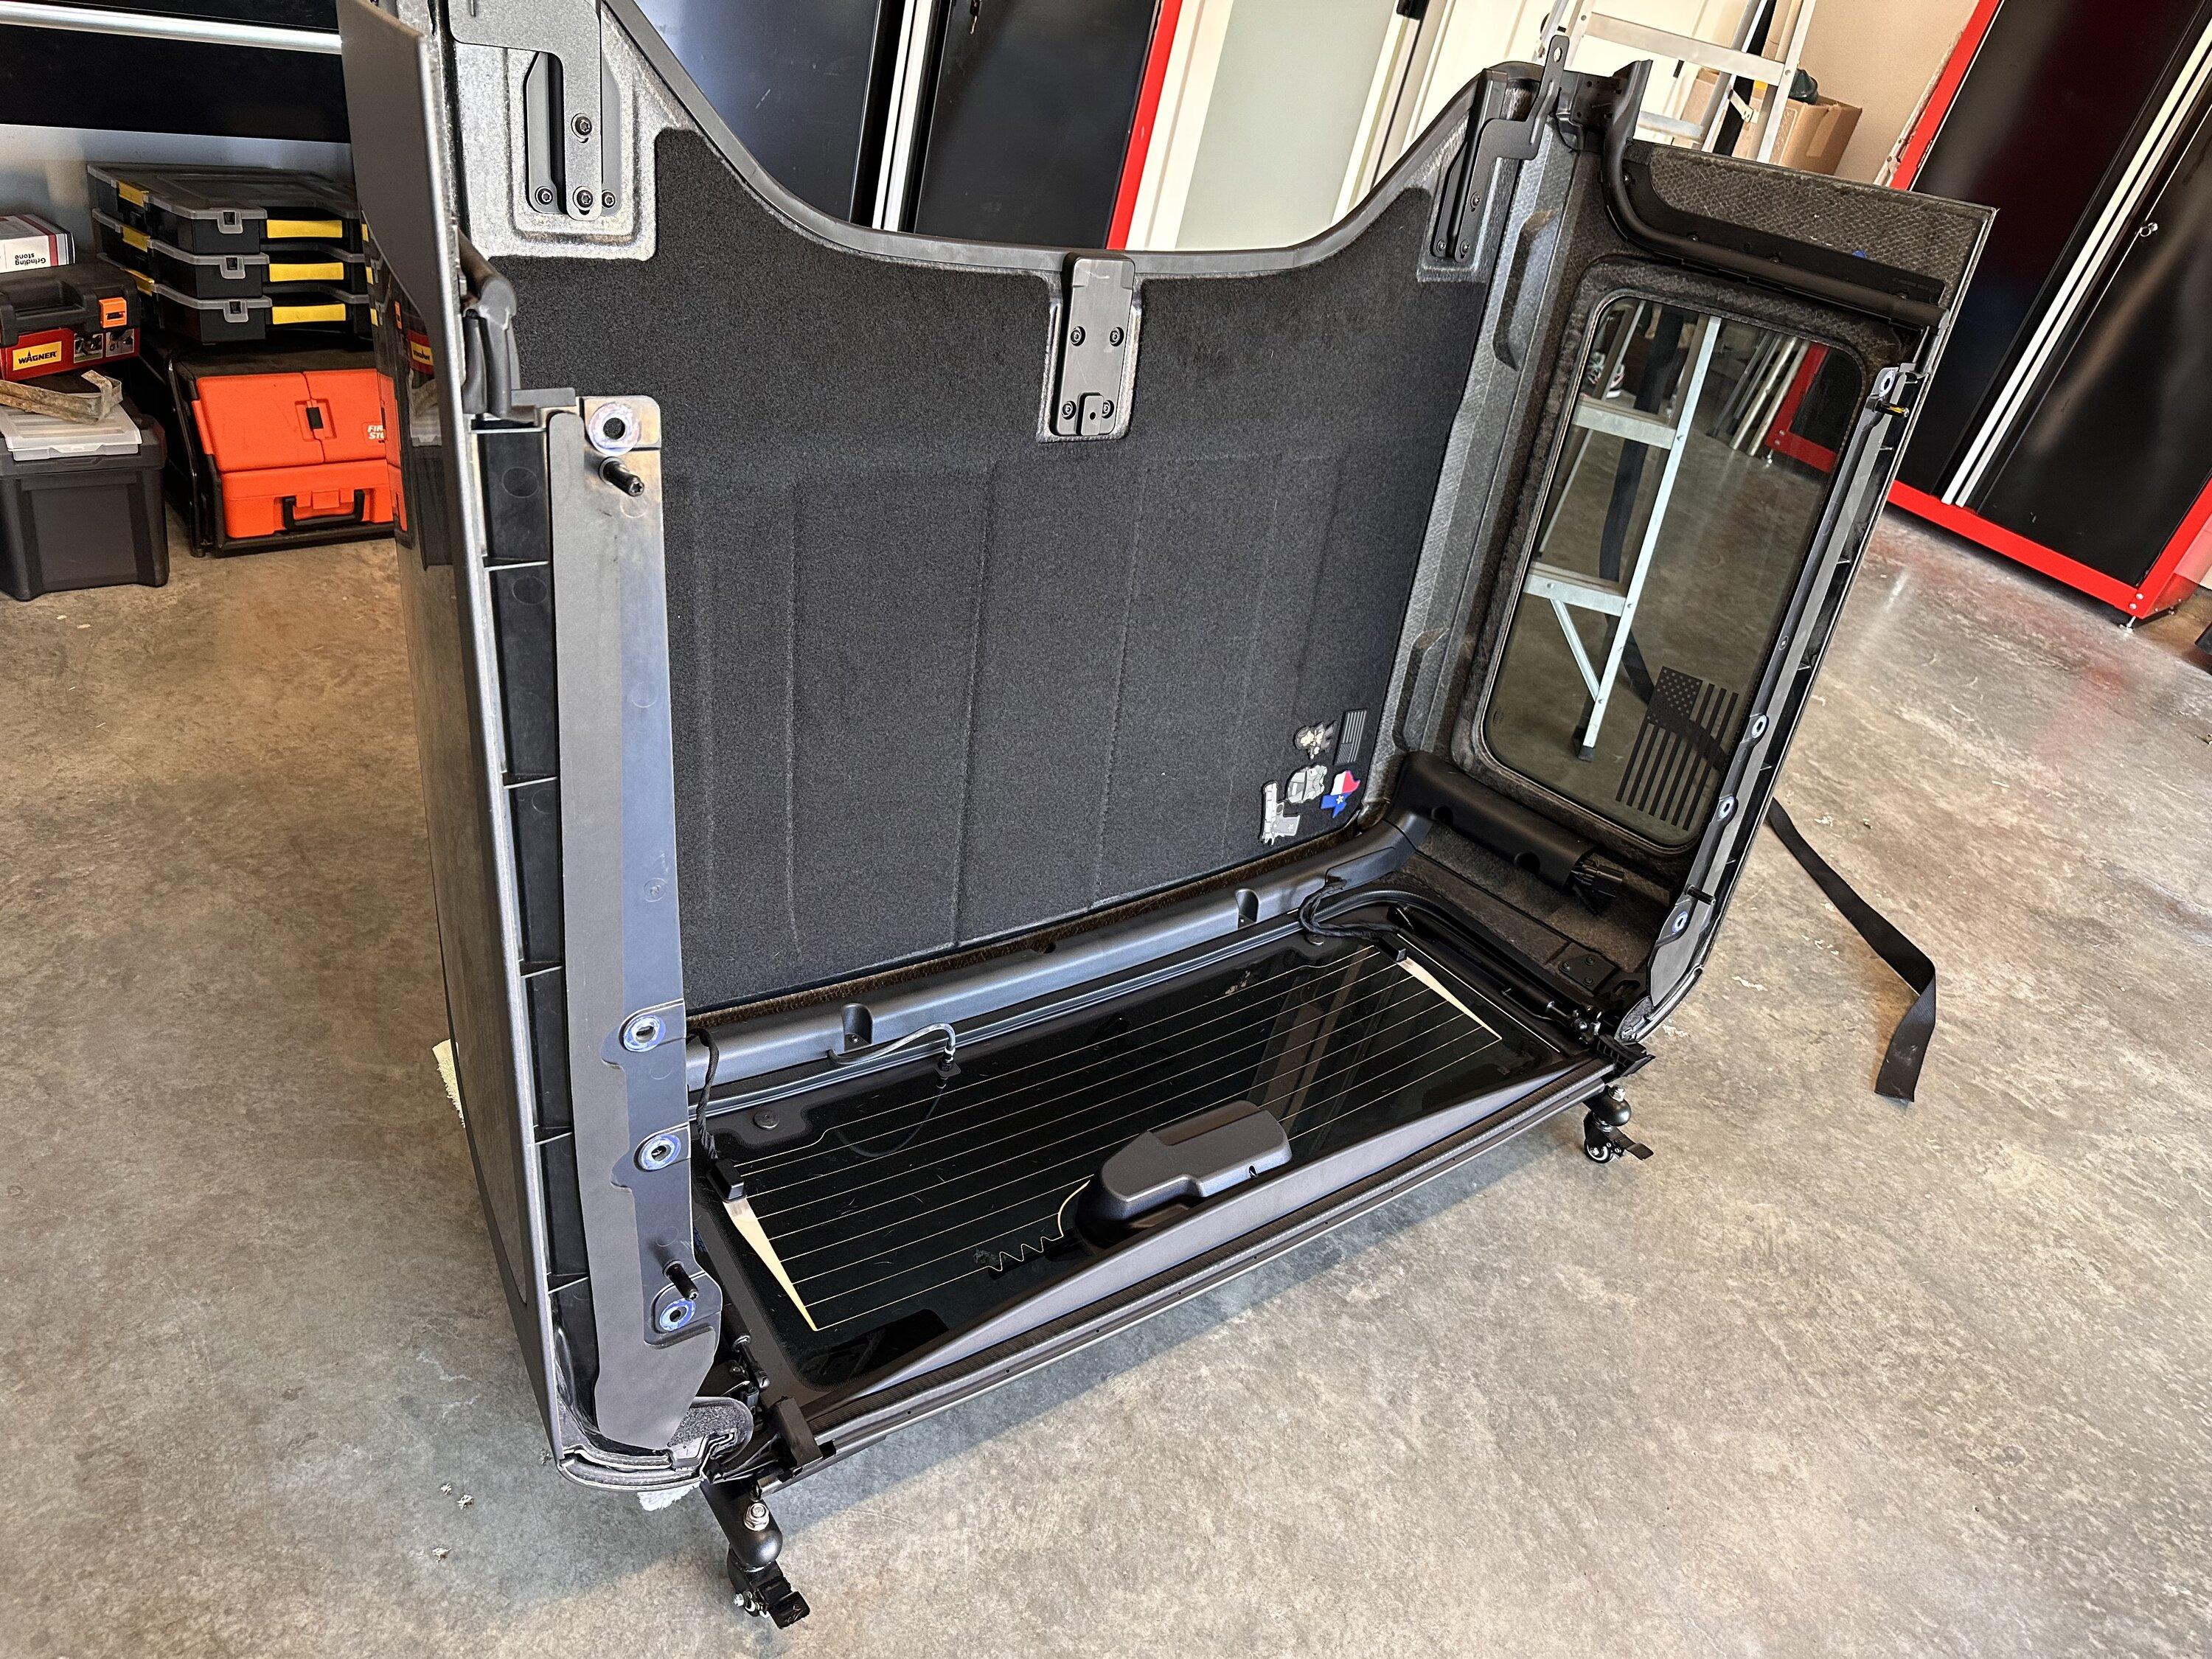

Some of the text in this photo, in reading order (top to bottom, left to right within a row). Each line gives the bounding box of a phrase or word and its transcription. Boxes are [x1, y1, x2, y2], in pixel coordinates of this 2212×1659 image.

[15, 257, 46, 265] Grinding
[18, 350, 57, 364] WAGNER
[367, 425, 383, 433] FIR
